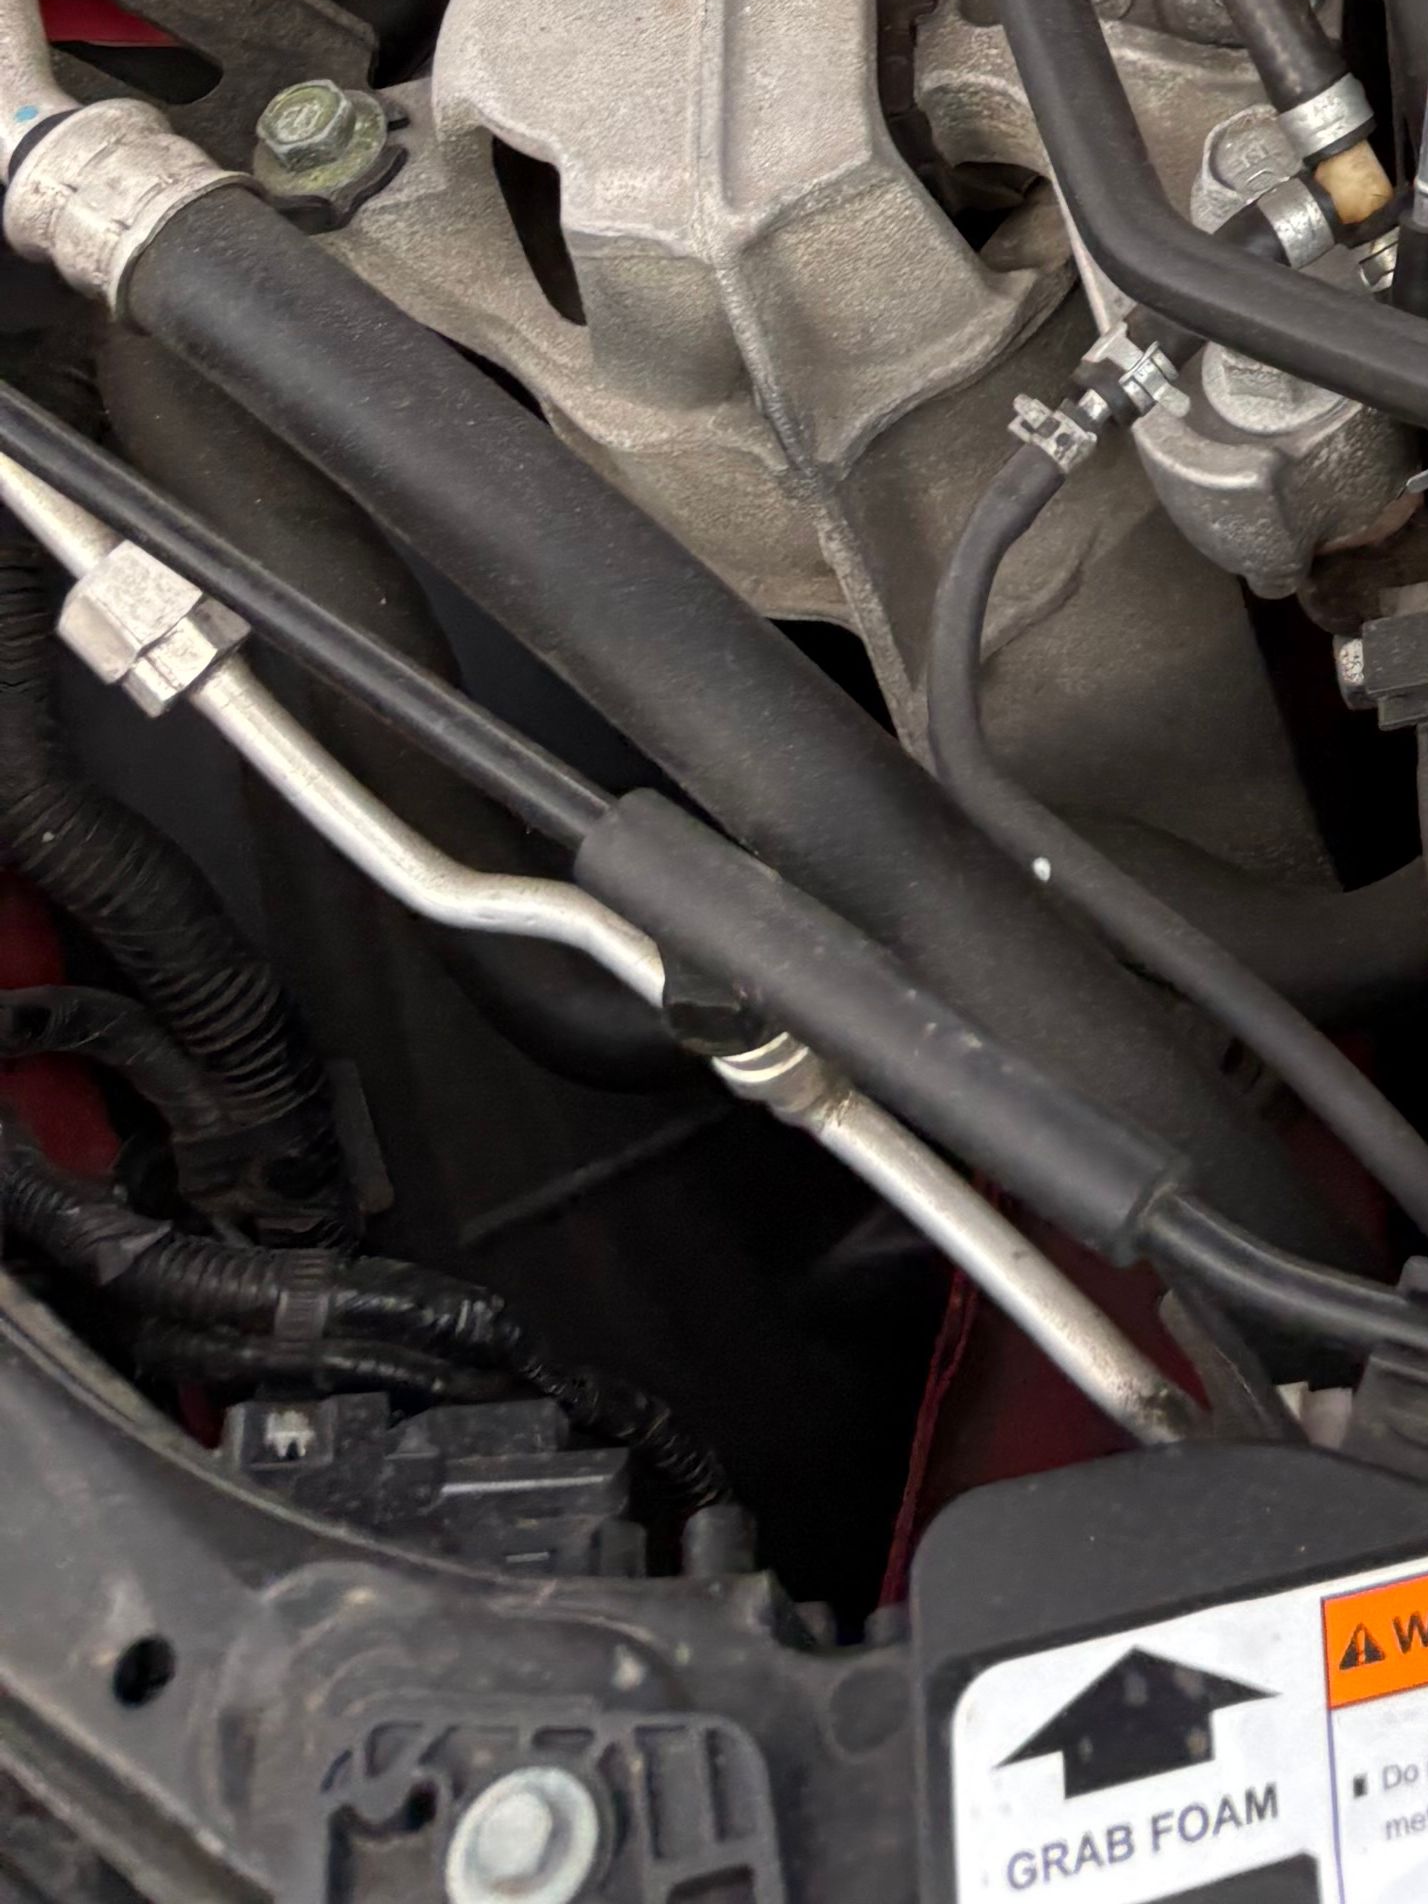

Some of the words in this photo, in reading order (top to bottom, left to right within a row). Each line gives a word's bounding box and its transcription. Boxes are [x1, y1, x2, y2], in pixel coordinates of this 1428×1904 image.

[1381, 1763, 1419, 1792] Do
[1005, 1824, 1135, 1892] GRAB
[1150, 1781, 1280, 1854] FOAM
